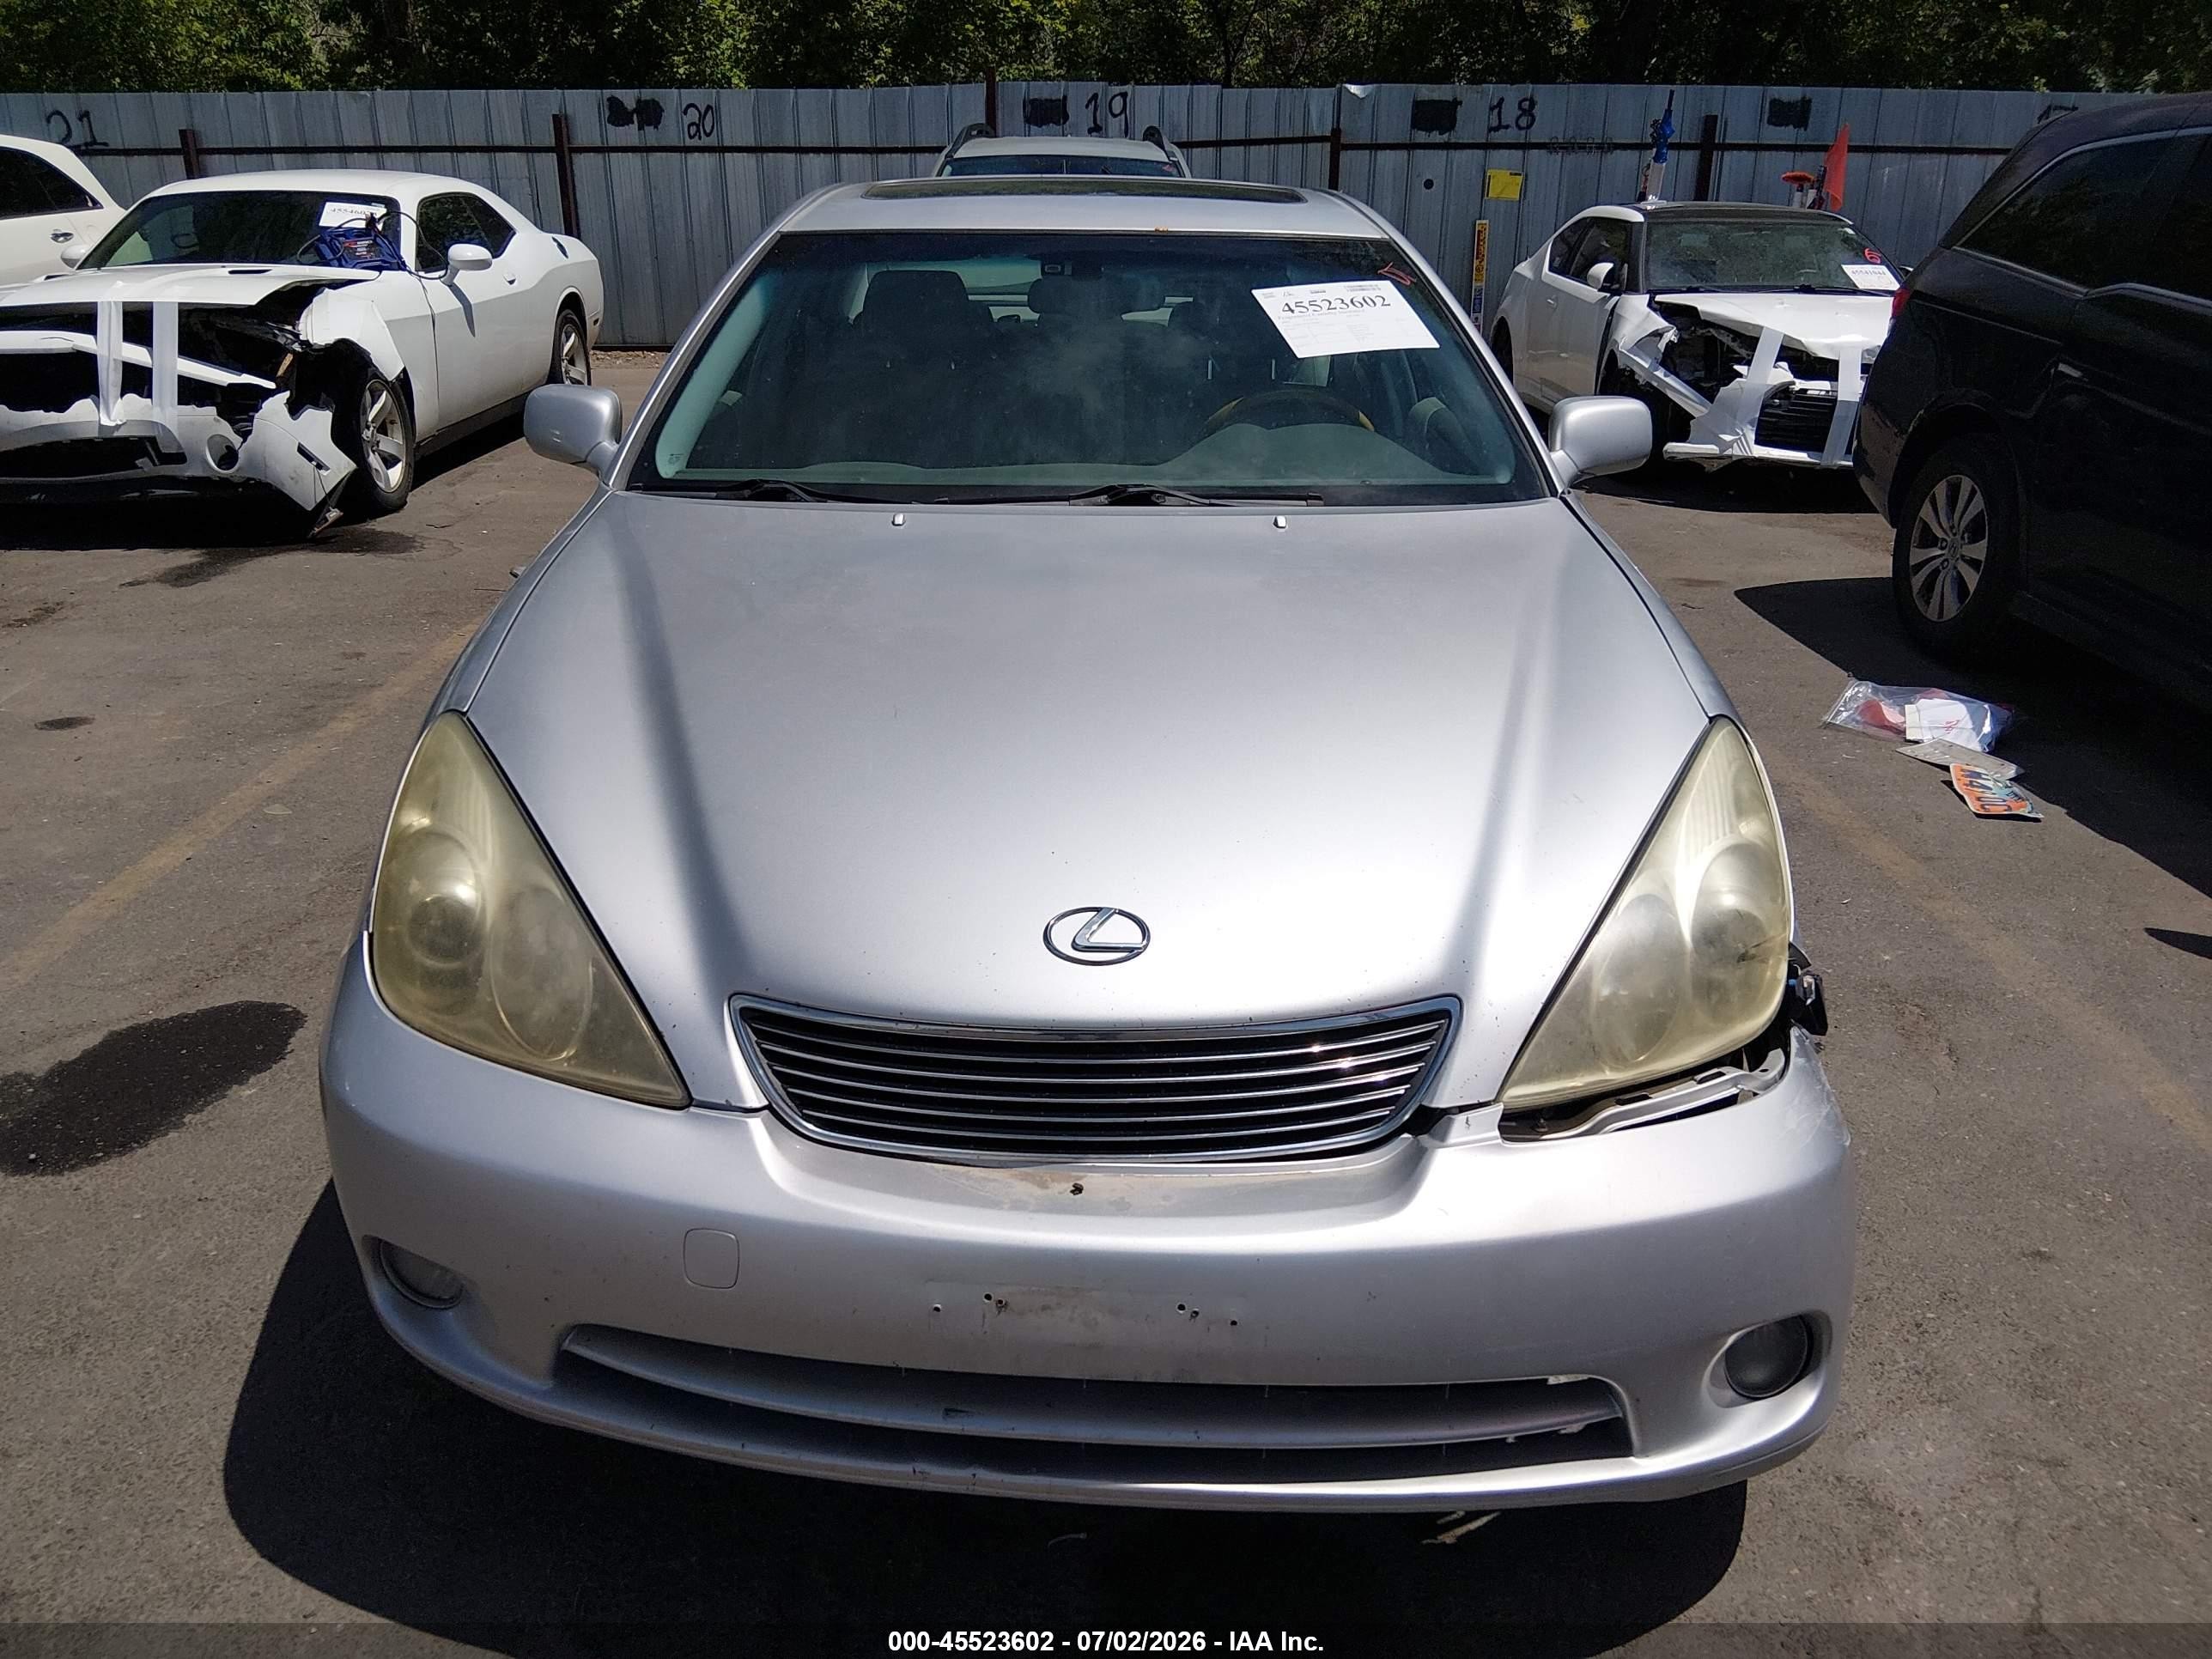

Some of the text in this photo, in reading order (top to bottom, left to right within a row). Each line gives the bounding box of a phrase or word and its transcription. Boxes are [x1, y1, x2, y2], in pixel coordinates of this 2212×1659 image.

[46, 110, 109, 148] 21
[682, 102, 715, 141] 20
[1085, 91, 1128, 137] 19
[1488, 96, 1537, 131] 18
[1282, 295, 1391, 314] 45523602
